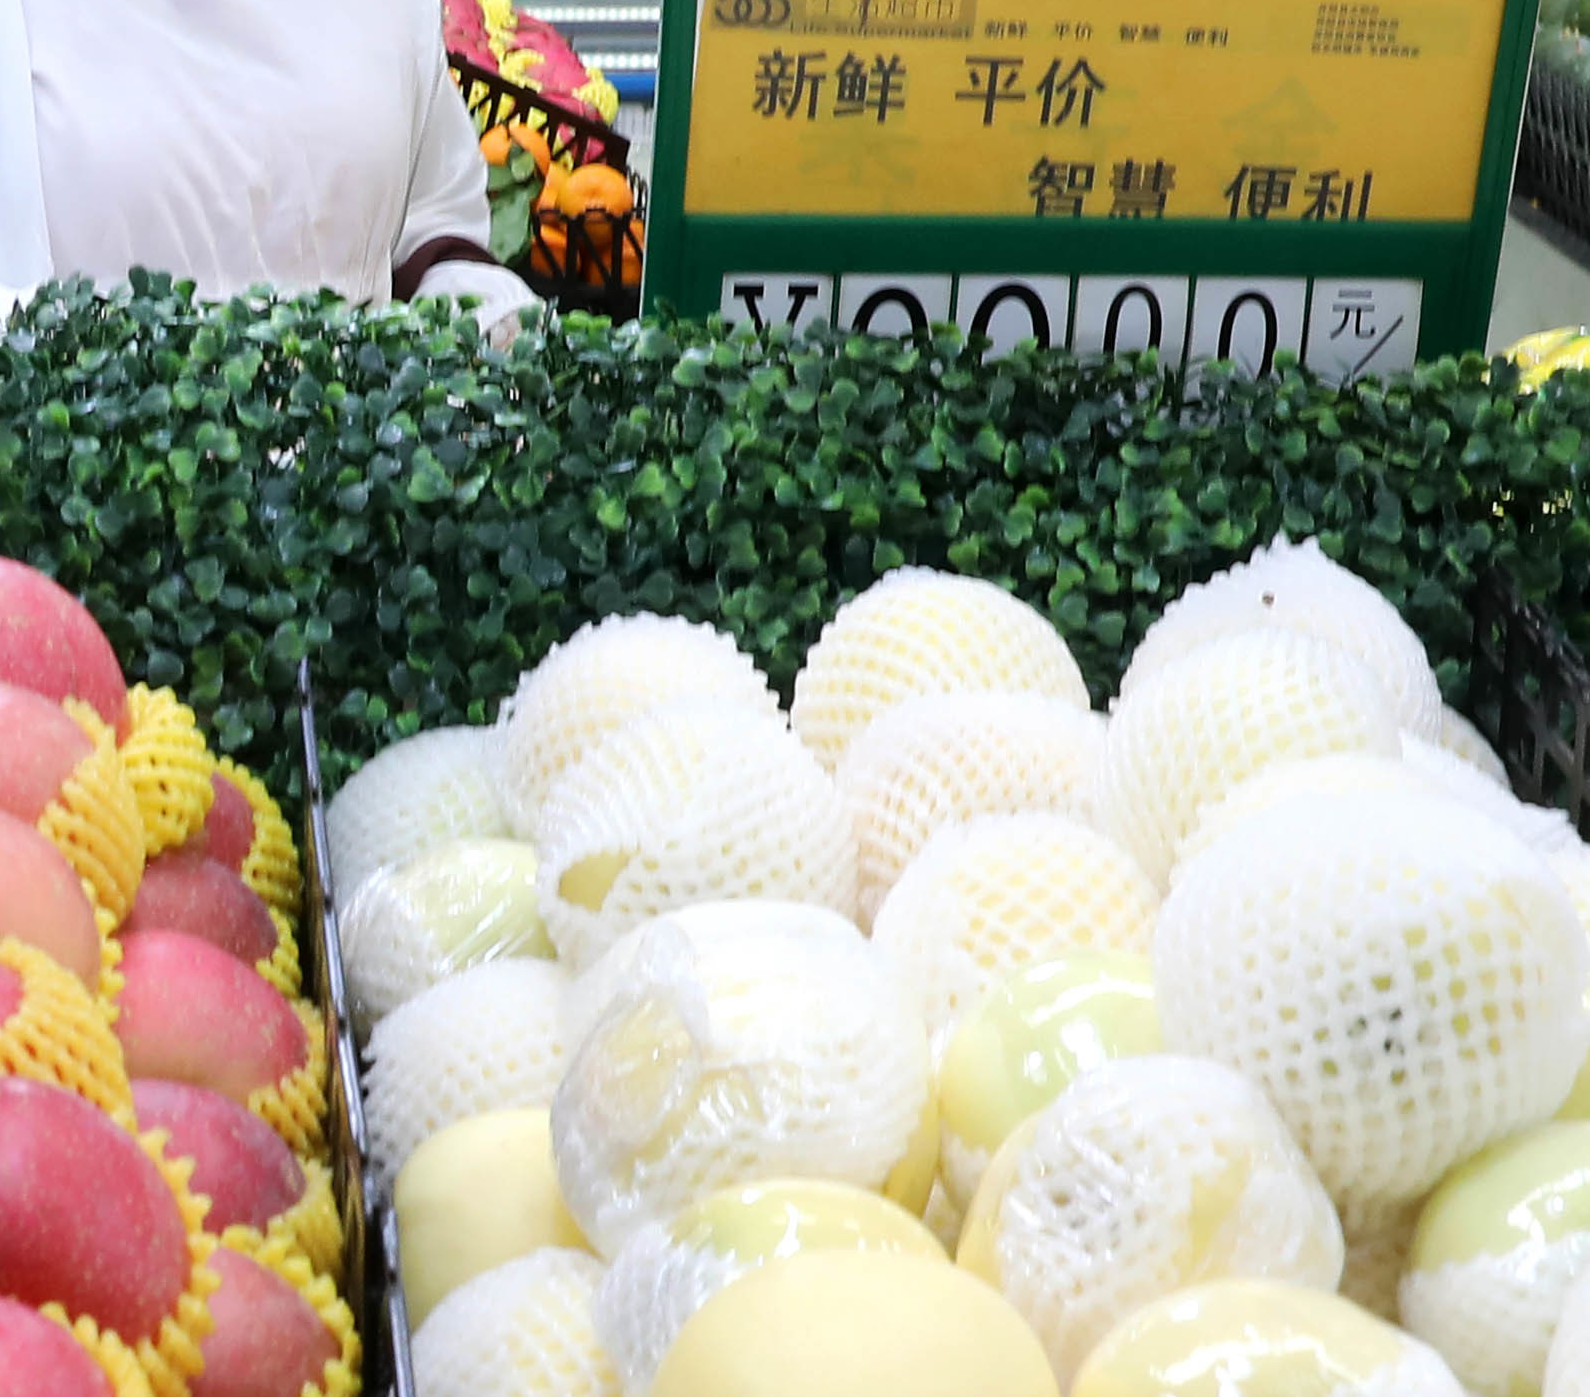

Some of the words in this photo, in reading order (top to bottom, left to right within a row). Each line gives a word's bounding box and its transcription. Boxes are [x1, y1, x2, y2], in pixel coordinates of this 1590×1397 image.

[752, 48, 907, 125] 新鲜
[954, 57, 1107, 128] 平价
[1223, 164, 1374, 222] 便利
